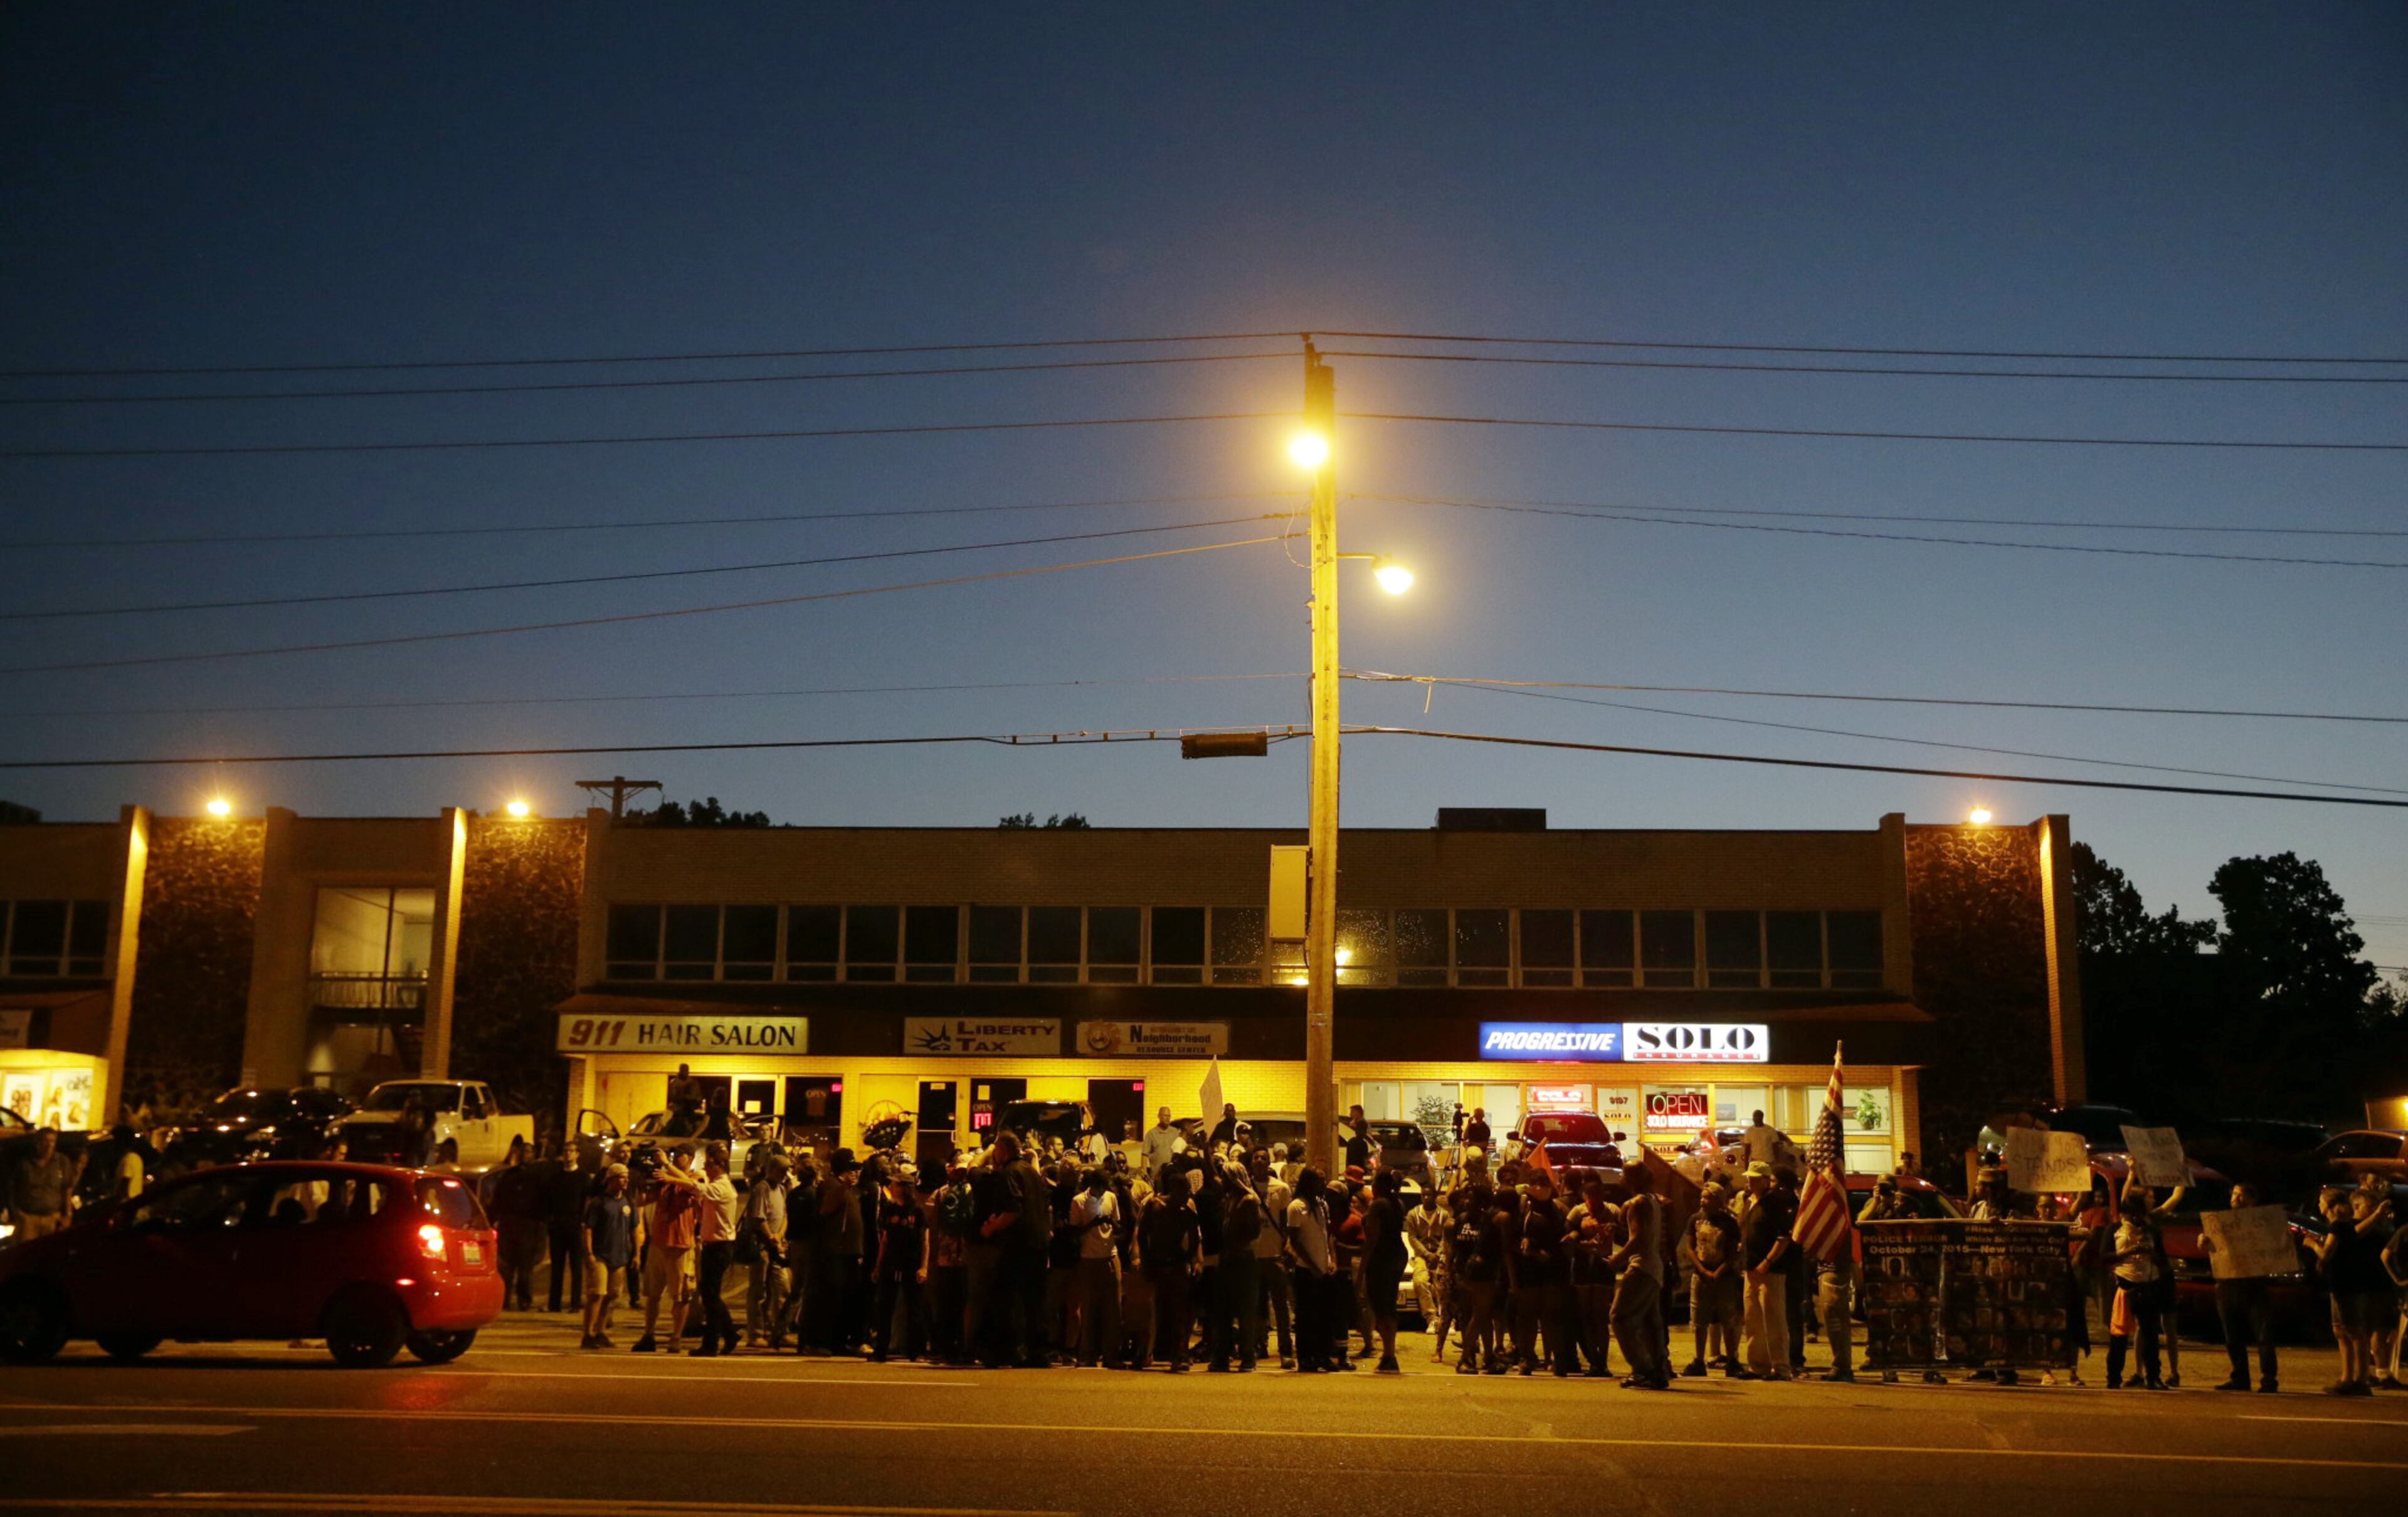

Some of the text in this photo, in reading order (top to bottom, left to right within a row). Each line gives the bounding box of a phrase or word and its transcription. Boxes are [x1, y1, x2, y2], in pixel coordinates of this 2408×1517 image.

[568, 1019, 796, 1047] 911 HAIR SALON
[957, 1021, 1056, 1036] LIBERTY
[1130, 1025, 1210, 1044] Neighborhood
[957, 1039, 1007, 1052] TAX
[1484, 1031, 1617, 1051] PROGRESSIVE
[1637, 1026, 1756, 1050] SOLO
[806, 1090, 827, 1098] OPEN
[973, 1104, 993, 1112] OPEN
[1652, 1094, 1703, 1114] OPEN
[1647, 1114, 1708, 1128] SOLO INSURANCE
[2014, 1154, 2078, 1173] STANDS
[1862, 1235, 1903, 1244] POLICE
[1869, 1245, 1916, 1254] October
[2008, 1245, 2034, 1254] York
[2036, 1245, 2061, 1255] City
